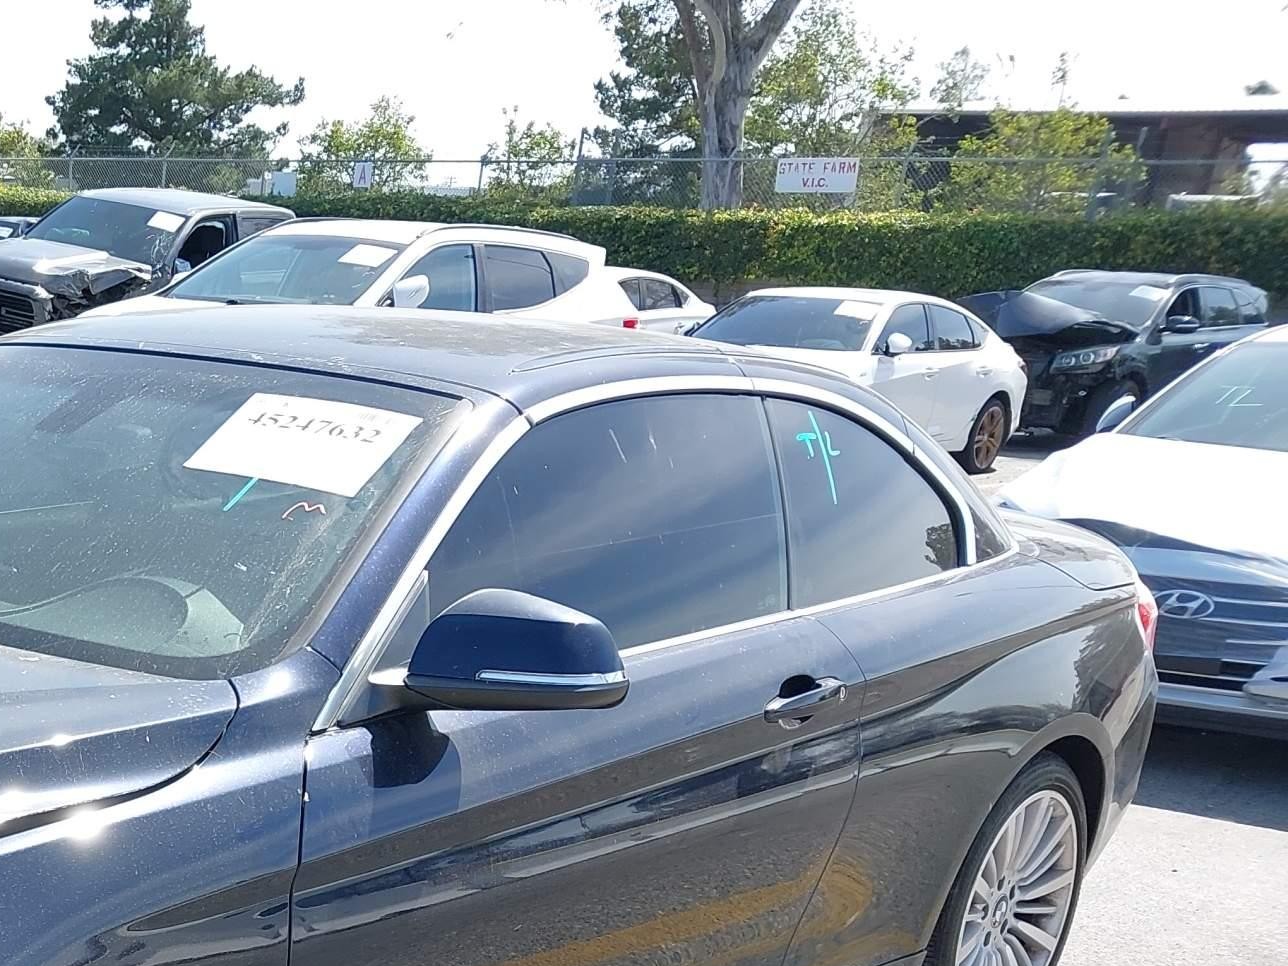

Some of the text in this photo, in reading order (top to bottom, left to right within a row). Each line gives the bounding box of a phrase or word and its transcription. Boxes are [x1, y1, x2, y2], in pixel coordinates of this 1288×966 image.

[358, 164, 367, 185] A
[779, 161, 857, 175] STATE FARM
[802, 177, 829, 188] V.I.C.
[248, 412, 382, 443] 45247632
